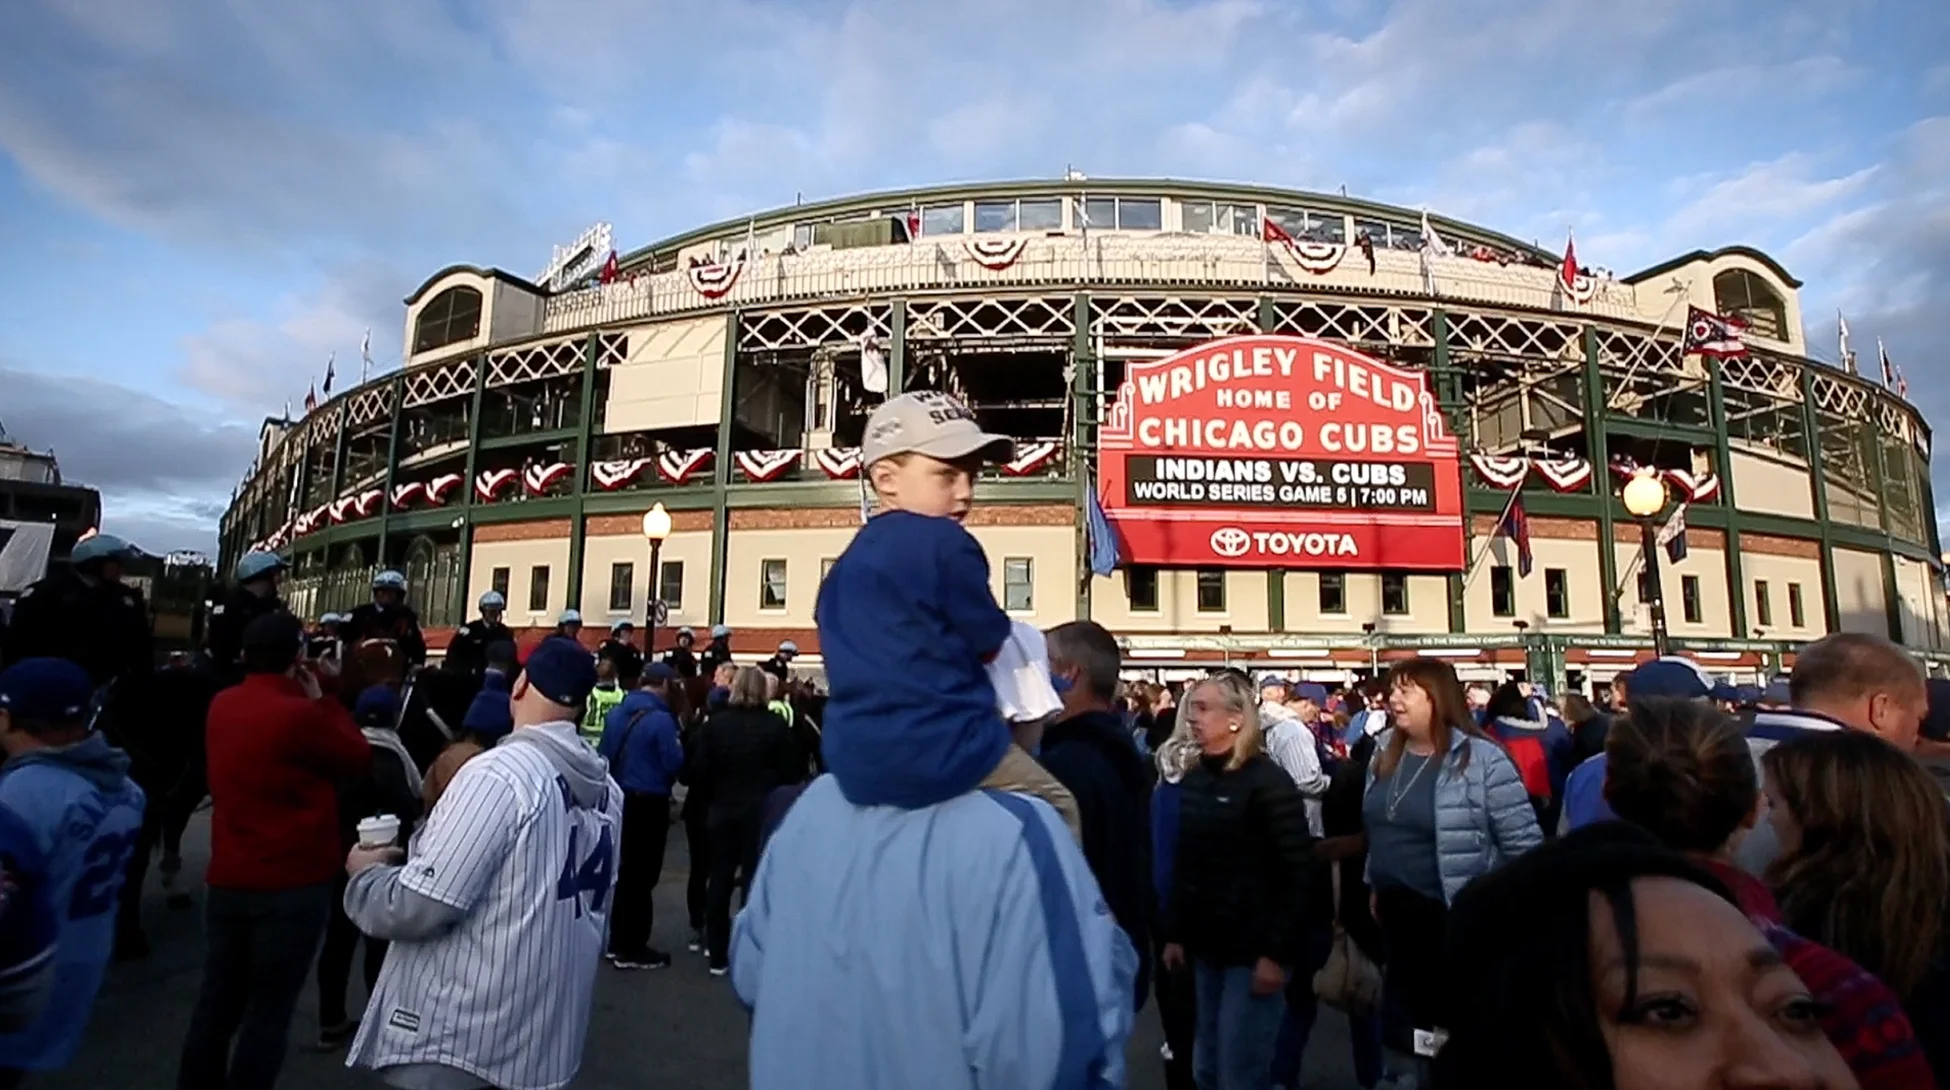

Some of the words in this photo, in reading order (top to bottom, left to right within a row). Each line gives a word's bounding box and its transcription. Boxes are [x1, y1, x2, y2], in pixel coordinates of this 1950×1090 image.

[1138, 347, 1298, 405] WRIGLEY
[1313, 351, 1416, 412] FIELD
[1216, 388, 1292, 409] HOME
[1308, 391, 1342, 411] OF
[1138, 417, 1303, 450] CHICAGO
[1319, 422, 1419, 454] CUBS
[1155, 457, 1272, 482] INDIANS
[1278, 461, 1324, 484] VS.
[1331, 463, 1407, 486] CUBS
[1134, 481, 1205, 500] WORLD
[1208, 483, 1276, 502] SERIES
[1279, 485, 1333, 503] GAME
[1360, 487, 1396, 505] 7:00
[1400, 488, 1428, 506] PM
[1253, 532, 1359, 556] TOYOTA
[557, 824, 613, 920] 44
